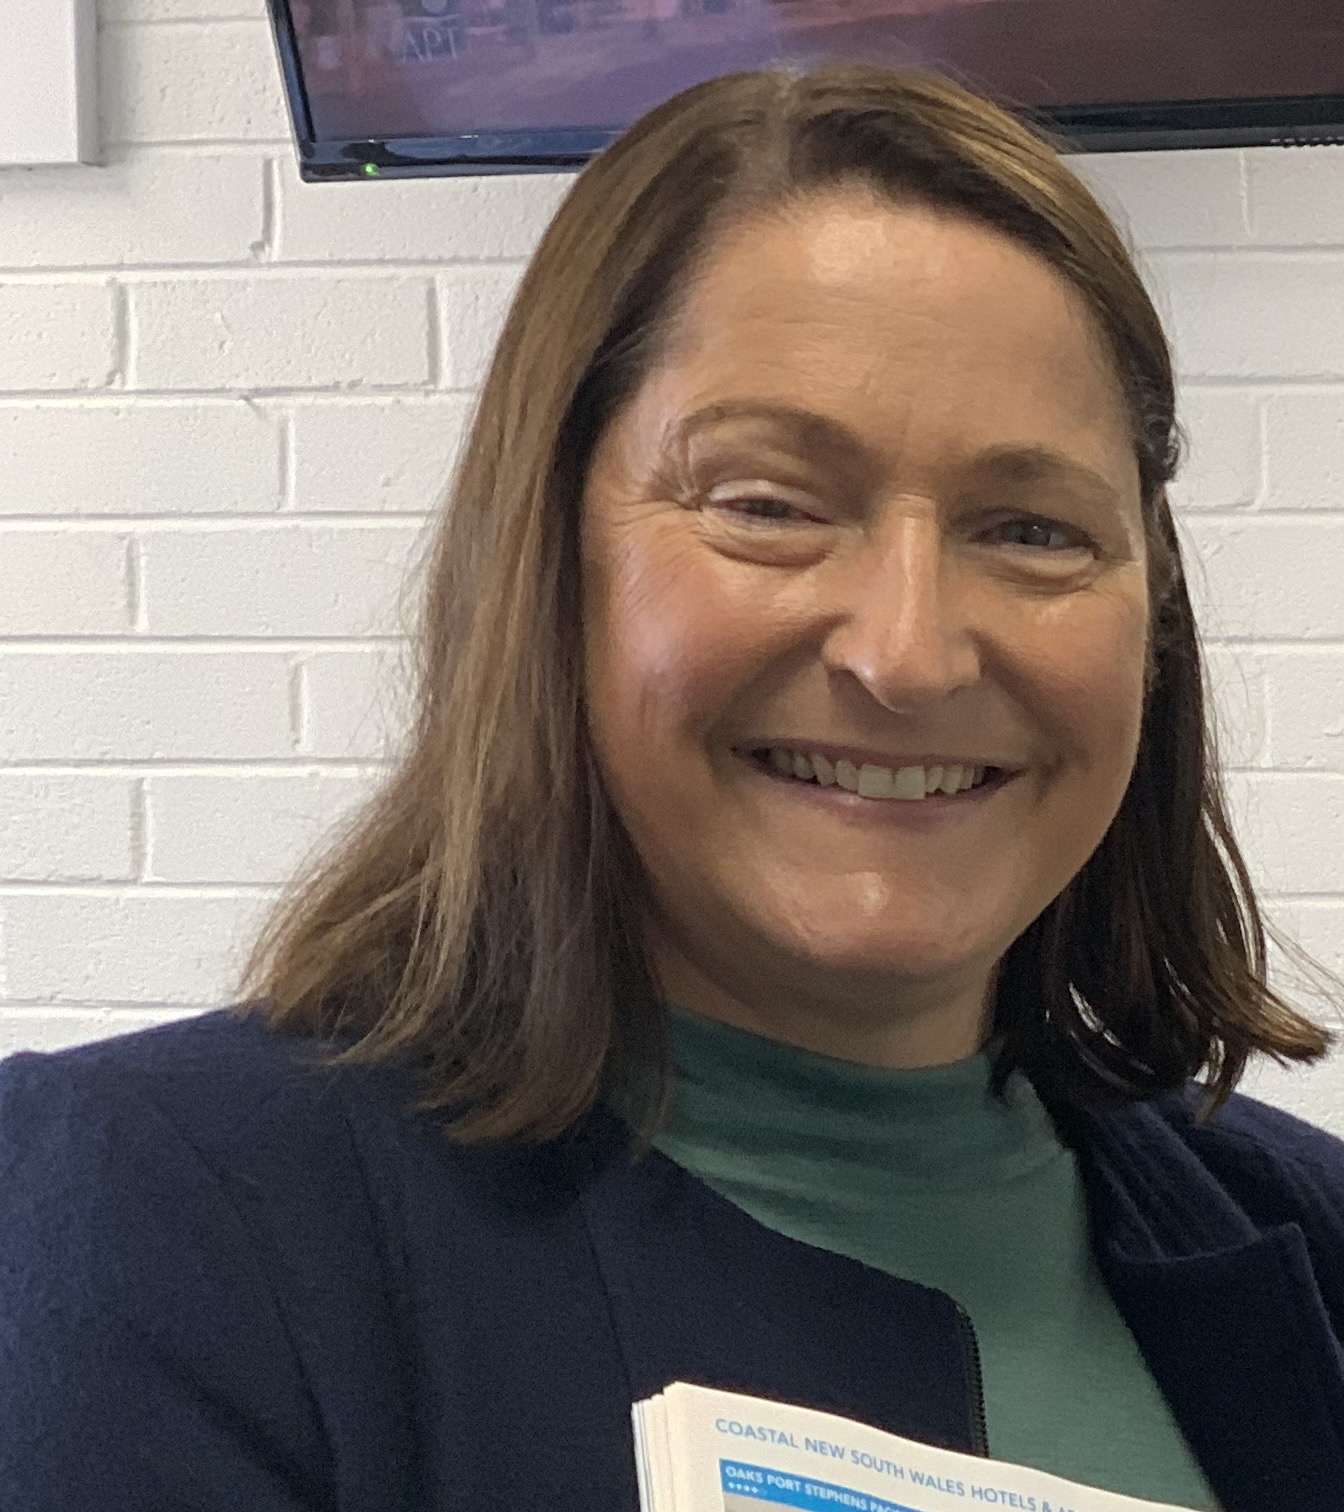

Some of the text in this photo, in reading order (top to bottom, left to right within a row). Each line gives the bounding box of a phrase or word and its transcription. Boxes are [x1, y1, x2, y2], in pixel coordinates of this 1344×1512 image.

[715, 1418, 799, 1449] COASTAL
[804, 1437, 845, 1459] NEW
[850, 1449, 905, 1479] SOUTH
[909, 1468, 965, 1498] WALES
[970, 1485, 1037, 1512] HOTELS
[725, 1466, 764, 1484] OAKS
[767, 1474, 802, 1492] PORT
[804, 1483, 868, 1511] STEPHENS
